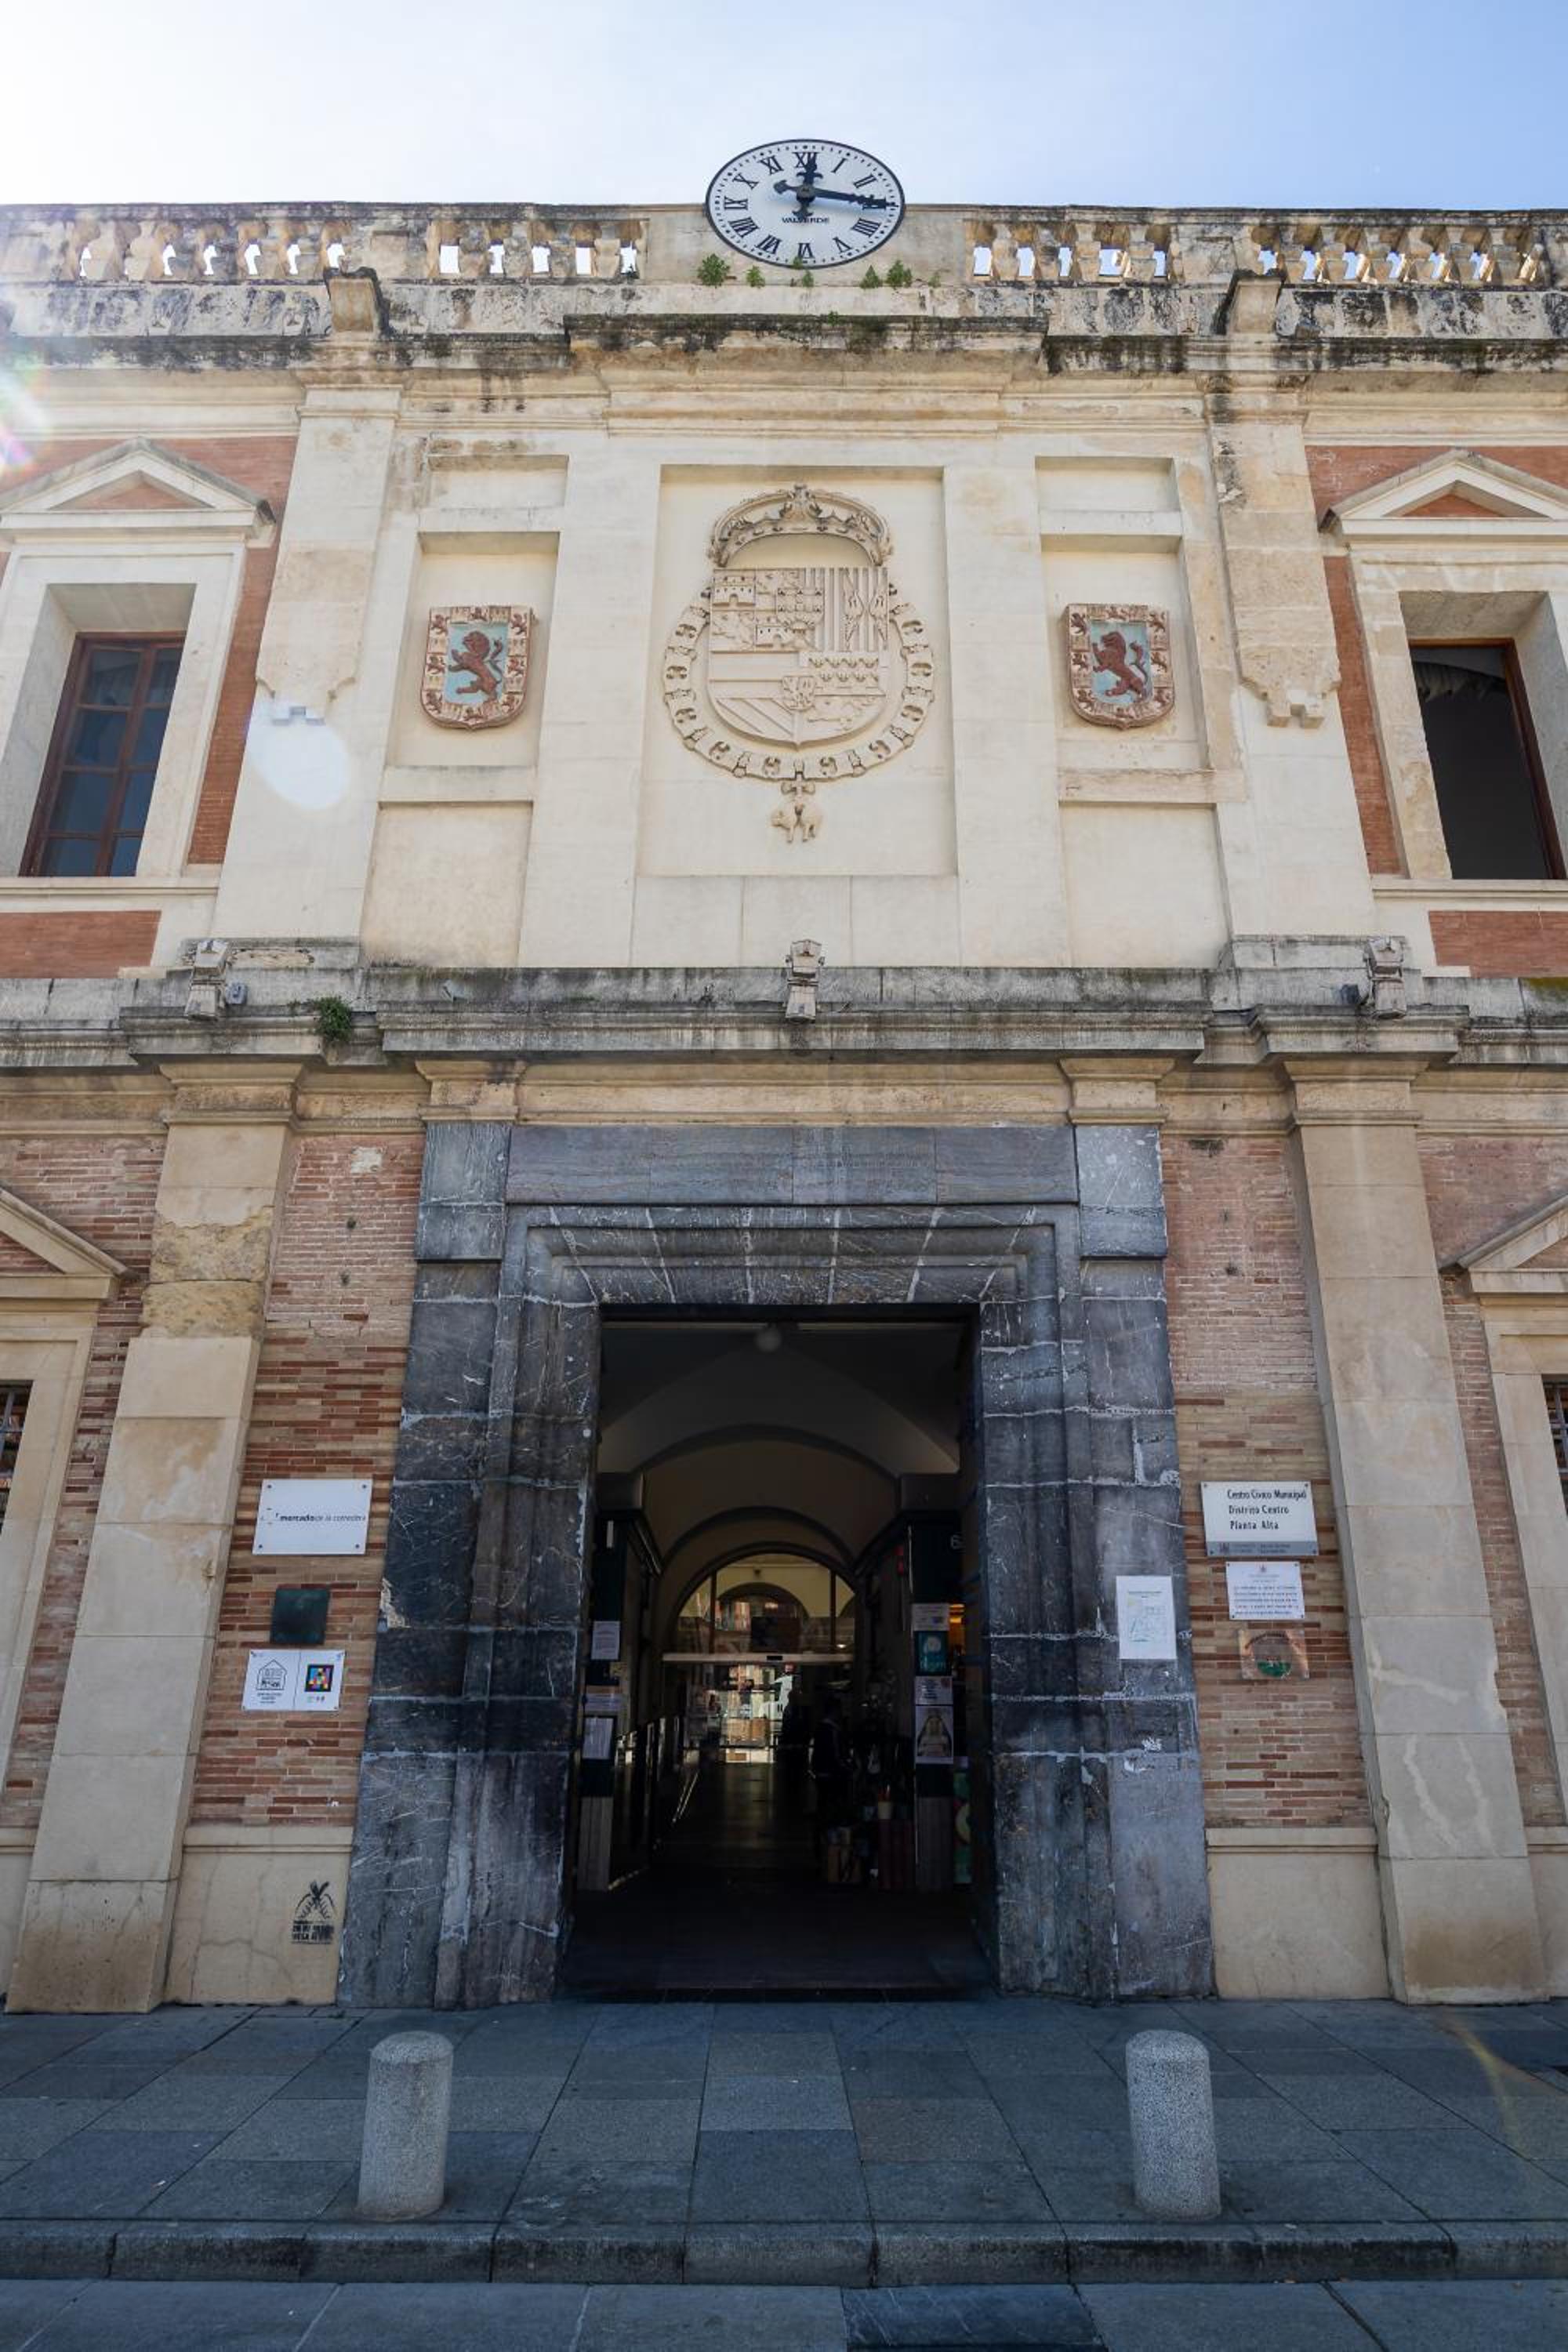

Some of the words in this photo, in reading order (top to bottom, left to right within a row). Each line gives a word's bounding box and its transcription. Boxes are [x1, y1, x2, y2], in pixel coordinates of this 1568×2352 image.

[759, 155, 784, 176] XI
[792, 151, 819, 169] XII
[830, 158, 848, 173] I
[731, 172, 759, 190] X
[853, 173, 878, 188] II
[724, 196, 748, 210] IX
[728, 216, 760, 238] VIII
[851, 217, 882, 238] IIII
[755, 234, 782, 255] VII
[797, 242, 815, 259] VI
[833, 236, 853, 253] V
[1227, 1490, 1250, 1500] Centro
[1274, 1489, 1307, 1501] Municipal
[1229, 1504, 1259, 1515] Distrito
[1261, 1504, 1290, 1515] Centro
[1230, 1520, 1257, 1530] Planta
[1261, 1520, 1279, 1530] Alta
